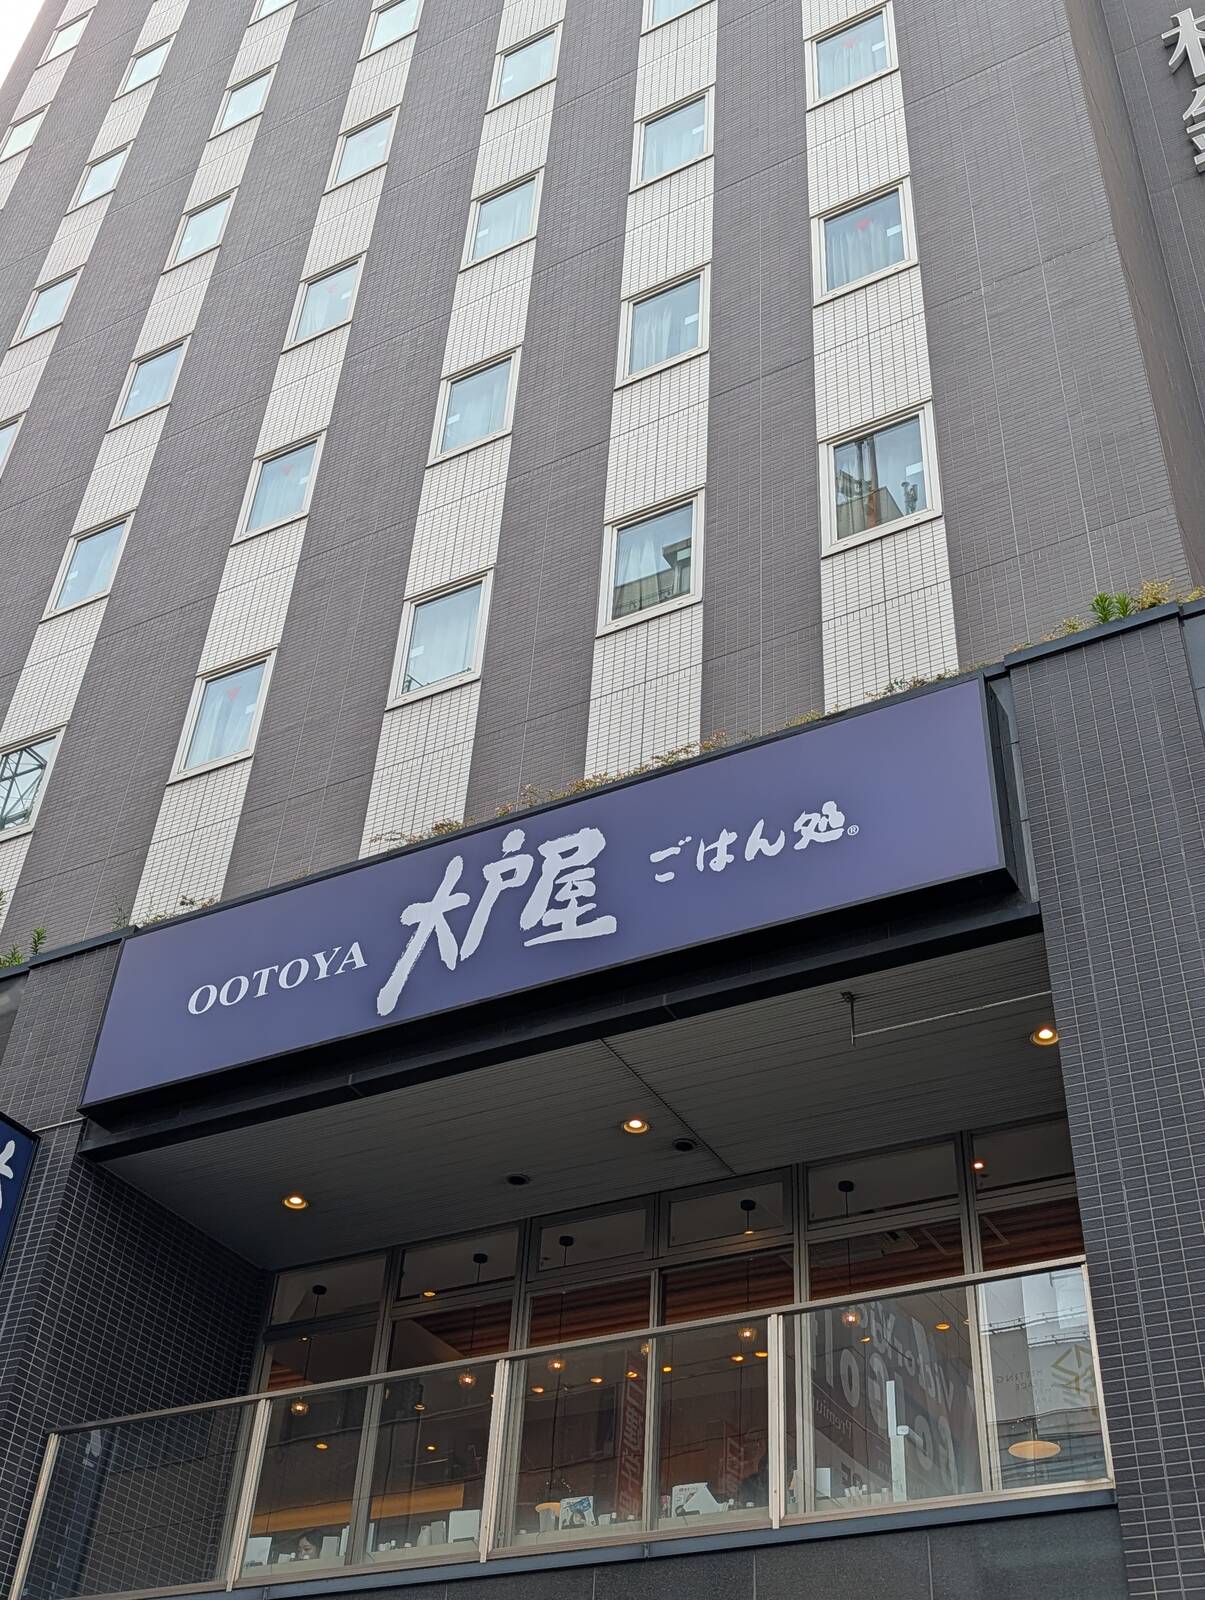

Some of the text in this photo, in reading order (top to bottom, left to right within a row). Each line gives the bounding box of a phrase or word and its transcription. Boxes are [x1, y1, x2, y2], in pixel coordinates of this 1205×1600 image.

[188, 942, 367, 1014] OOTOYA
[376, 827, 617, 1016] 大戸屋
